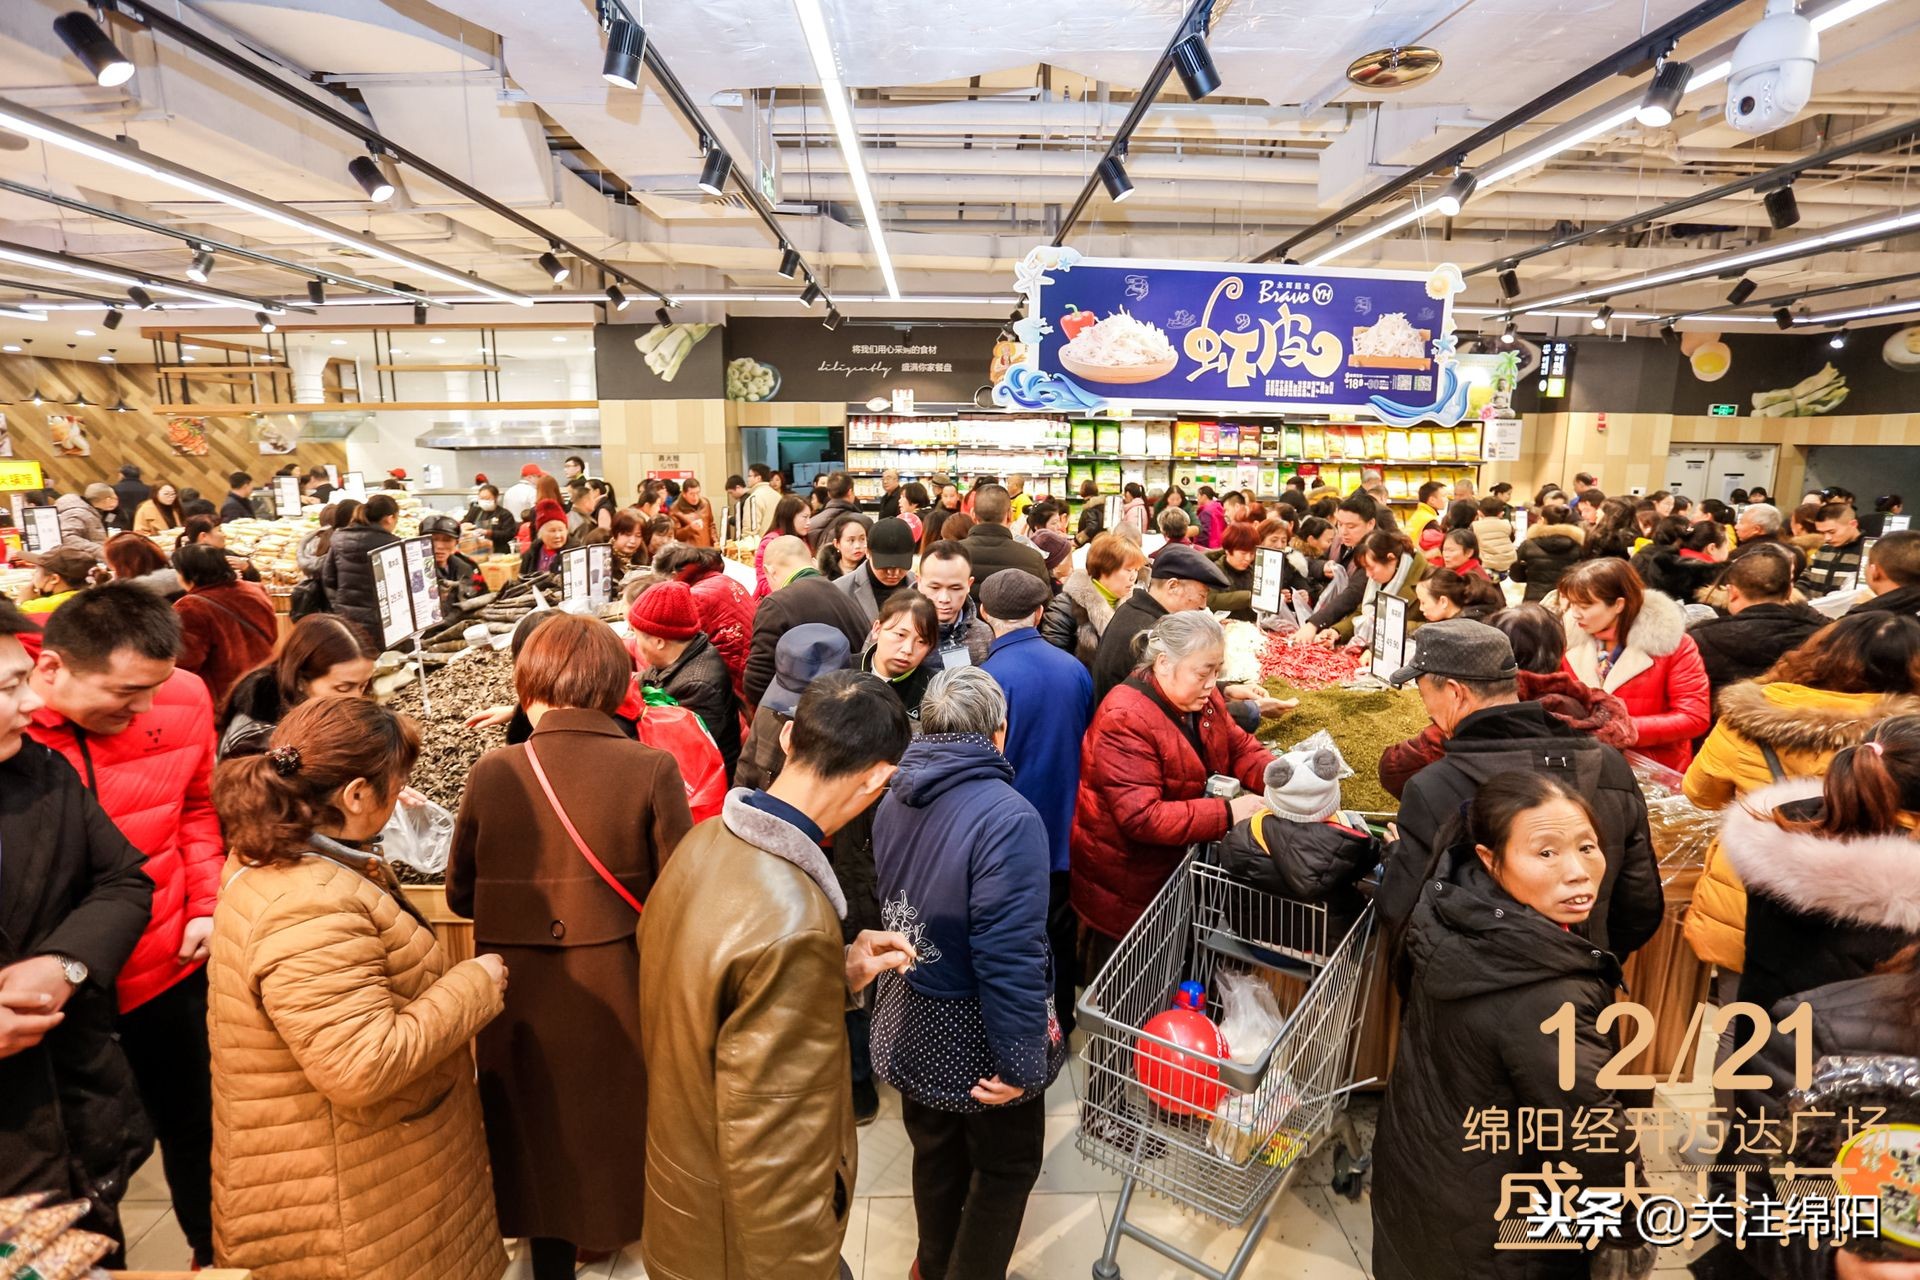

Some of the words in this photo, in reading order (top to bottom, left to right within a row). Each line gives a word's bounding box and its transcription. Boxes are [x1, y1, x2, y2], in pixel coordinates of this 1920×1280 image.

[1258, 280, 1311, 304] Bravo
[1276, 281, 1312, 290] 永辉超市
[1184, 276, 1343, 388] 虾皮
[818, 361, 892, 378] diligently
